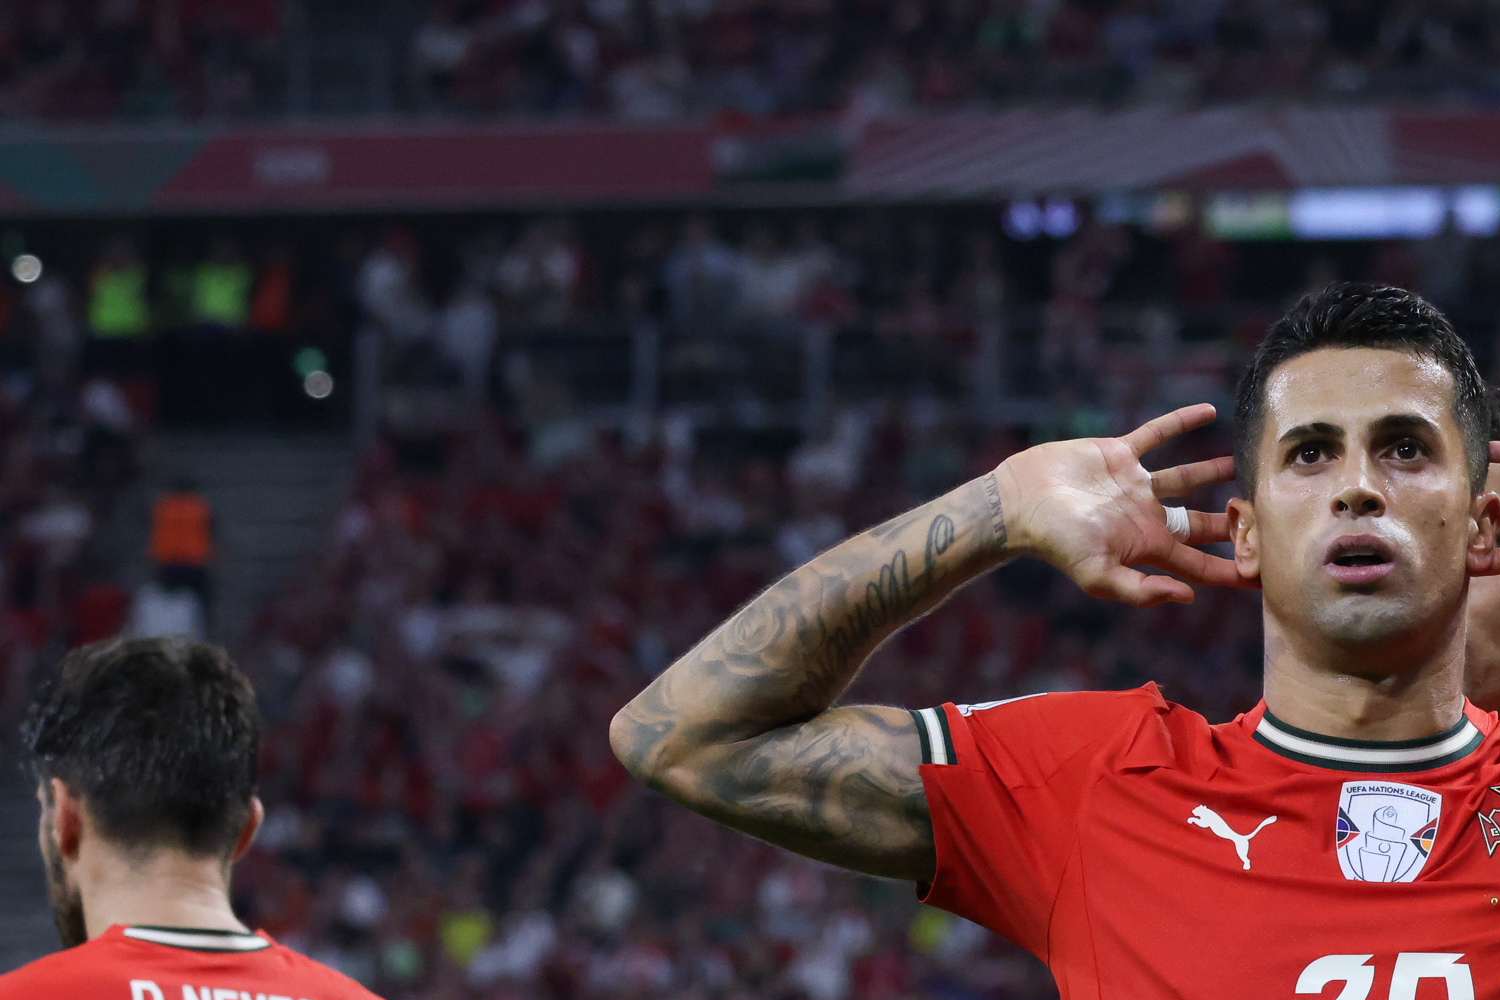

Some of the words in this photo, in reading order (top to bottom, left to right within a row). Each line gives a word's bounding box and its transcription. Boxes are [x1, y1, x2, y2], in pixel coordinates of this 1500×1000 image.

[1346, 785, 1367, 794] UEFA
[1368, 785, 1405, 795] NATIONS
[1405, 789, 1437, 804] LEAGUE
